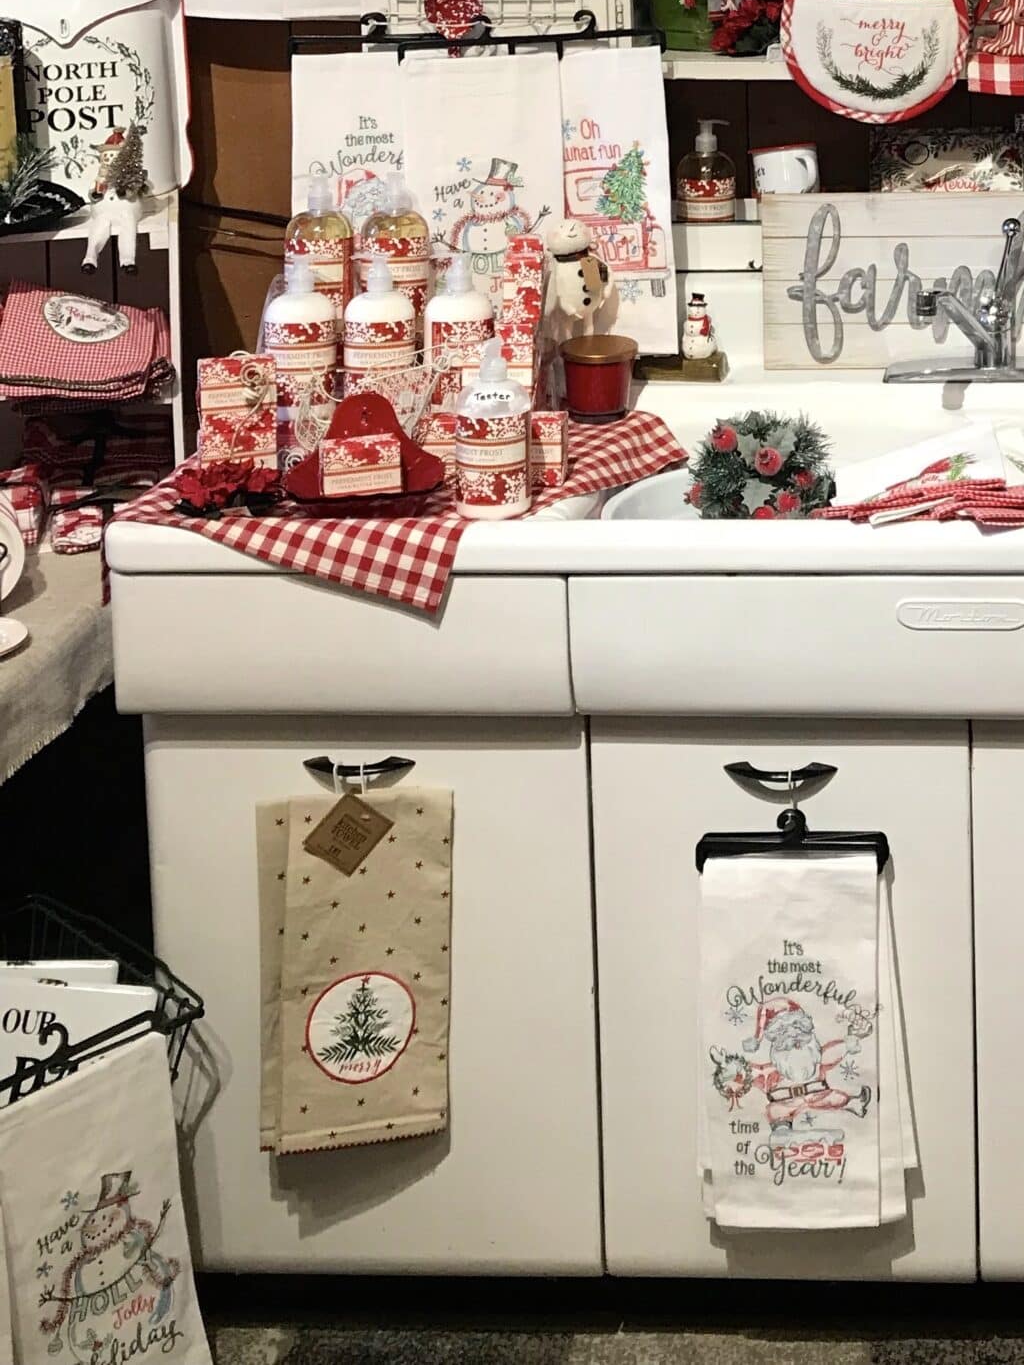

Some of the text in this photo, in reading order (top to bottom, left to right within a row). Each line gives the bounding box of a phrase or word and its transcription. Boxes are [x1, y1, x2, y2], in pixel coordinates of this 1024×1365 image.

[848, 18, 914, 44] merry
[848, 44, 910, 72] bright
[25, 61, 119, 82] NORTH
[39, 85, 106, 105] POLE
[26, 105, 123, 132] POST
[359, 115, 378, 130] It's
[580, 118, 601, 140] Oh
[345, 132, 395, 147] the most
[433, 178, 471, 203] Have
[453, 198, 464, 209] a
[783, 940, 804, 956] It's
[768, 959, 822, 974] the most
[726, 974, 857, 1010] Wonderful
[339, 1058, 382, 1074] merry
[729, 1120, 760, 1135] time
[736, 1140, 751, 1155] of
[734, 1159, 755, 1175] the
[755, 1144, 847, 1186] Year!
[37, 1214, 80, 1257] Have
[61, 1241, 73, 1254] a
[112, 1294, 156, 1330] Jolly
